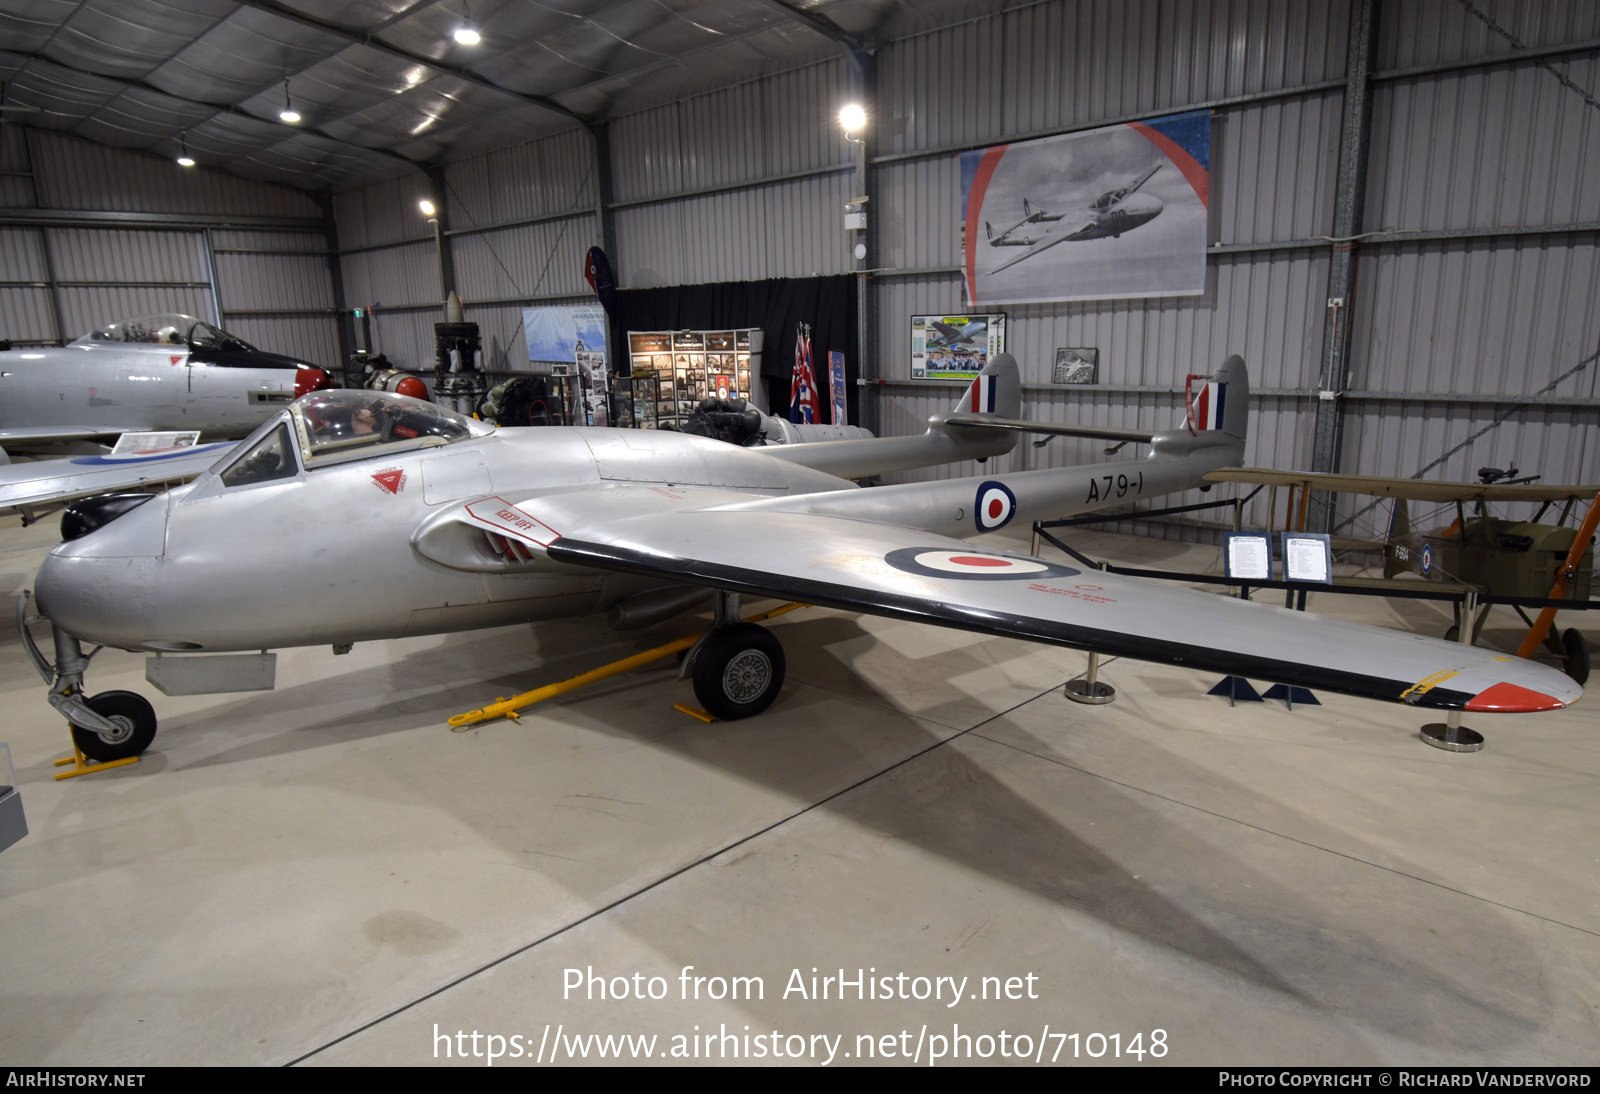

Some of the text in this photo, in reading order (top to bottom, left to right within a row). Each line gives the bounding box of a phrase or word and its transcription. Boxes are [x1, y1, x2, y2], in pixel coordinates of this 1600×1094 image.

[375, 466, 397, 474] DANGER
[1085, 471, 1143, 504] A79-1
[495, 508, 536, 531] KEEP OFF
